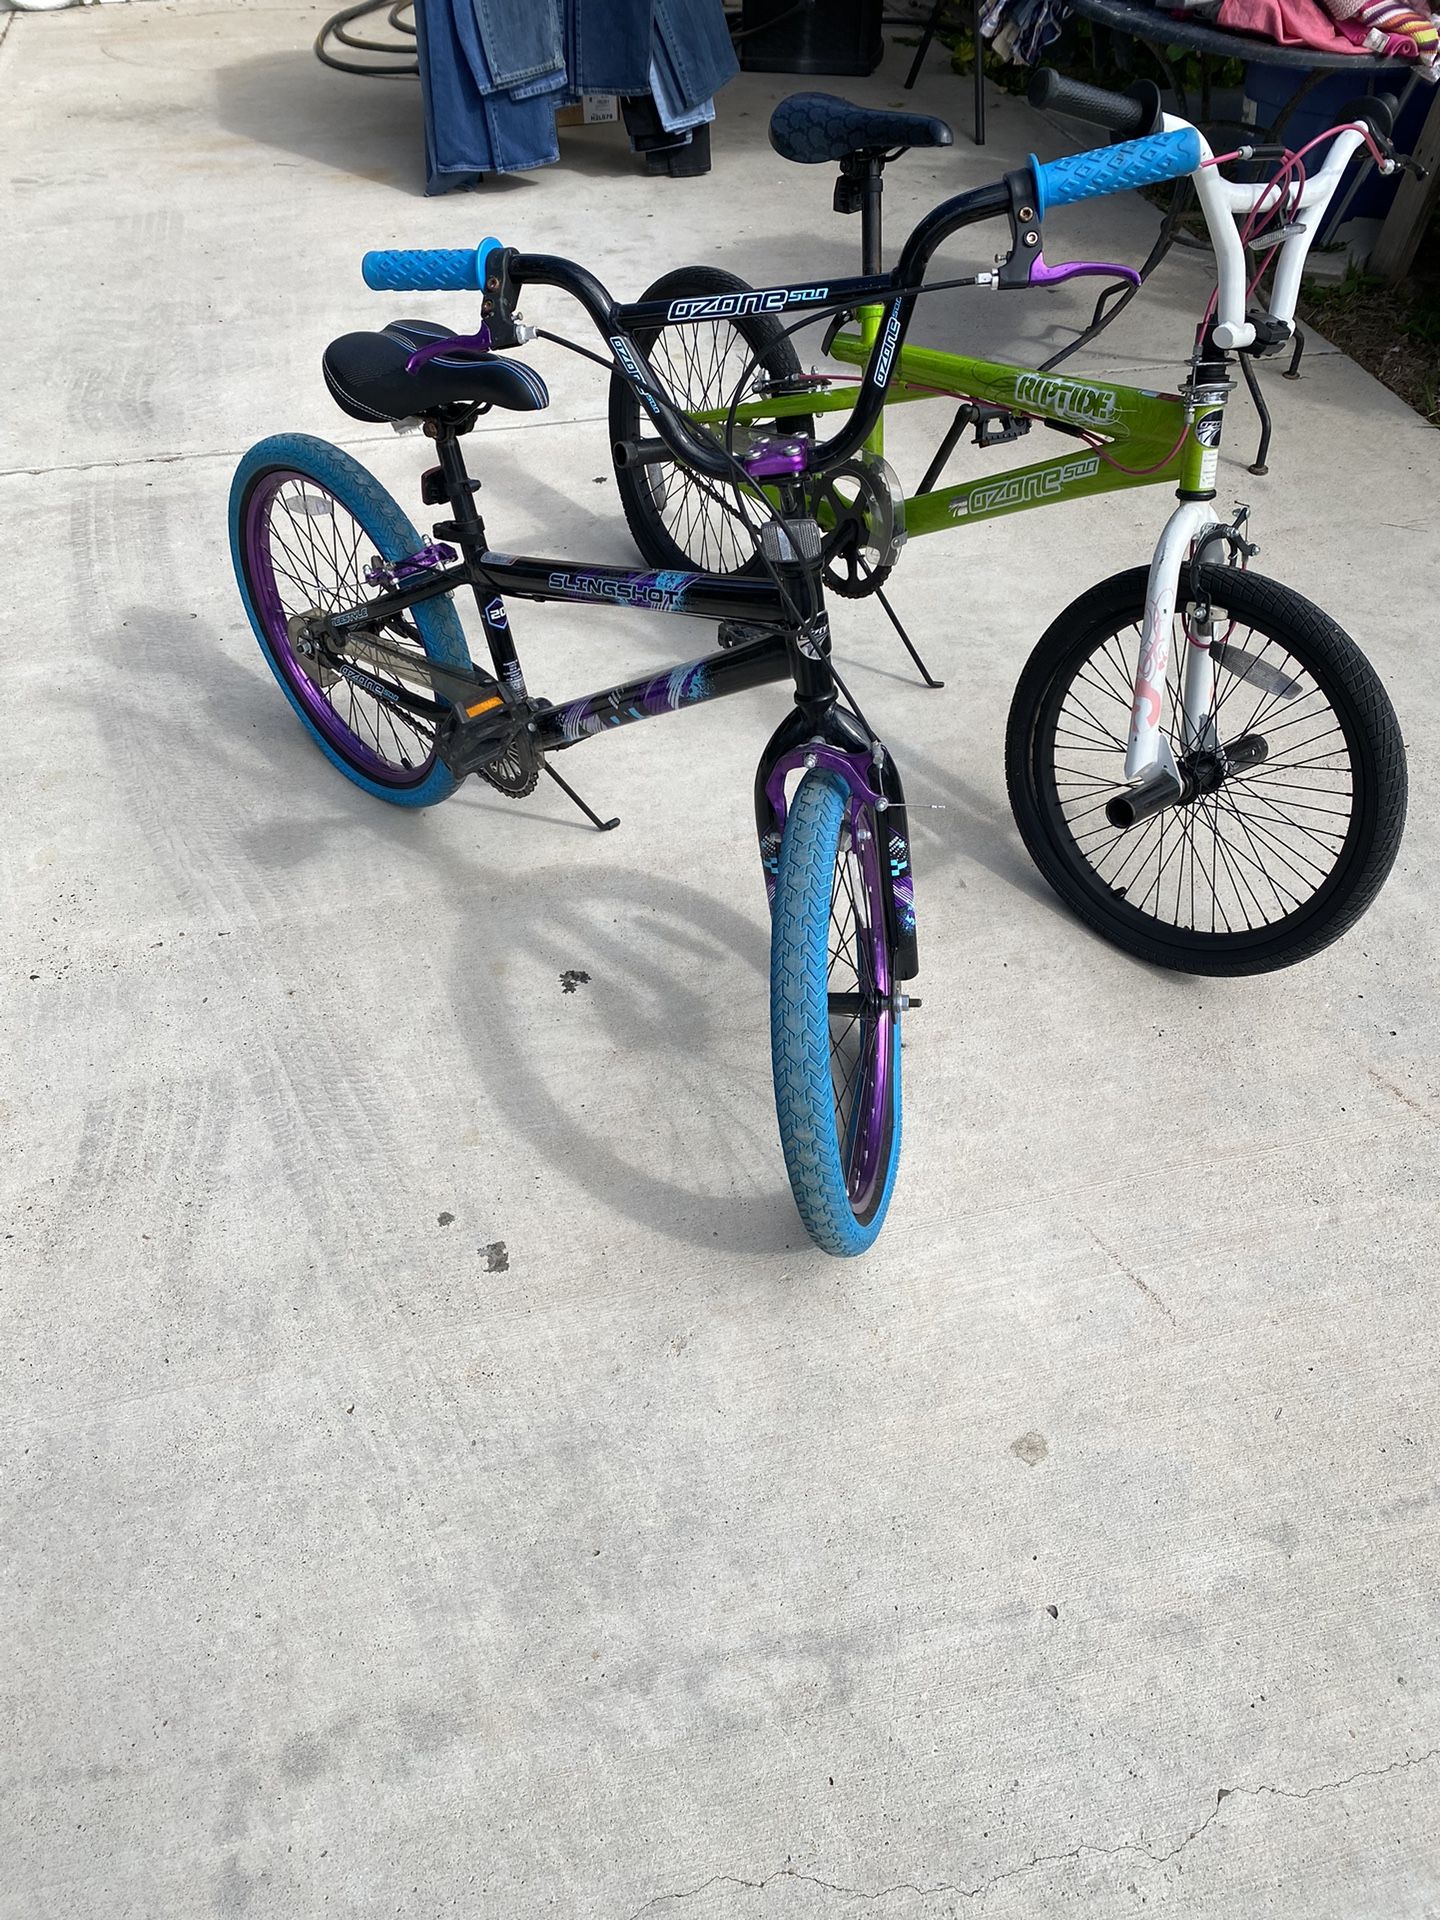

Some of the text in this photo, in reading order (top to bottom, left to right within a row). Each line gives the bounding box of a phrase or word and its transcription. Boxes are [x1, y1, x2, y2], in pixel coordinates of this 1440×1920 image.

[788, 287, 829, 302] 500
[1015, 374, 1117, 421] RIPTIDE
[548, 572, 683, 605] SLINGSHOT
